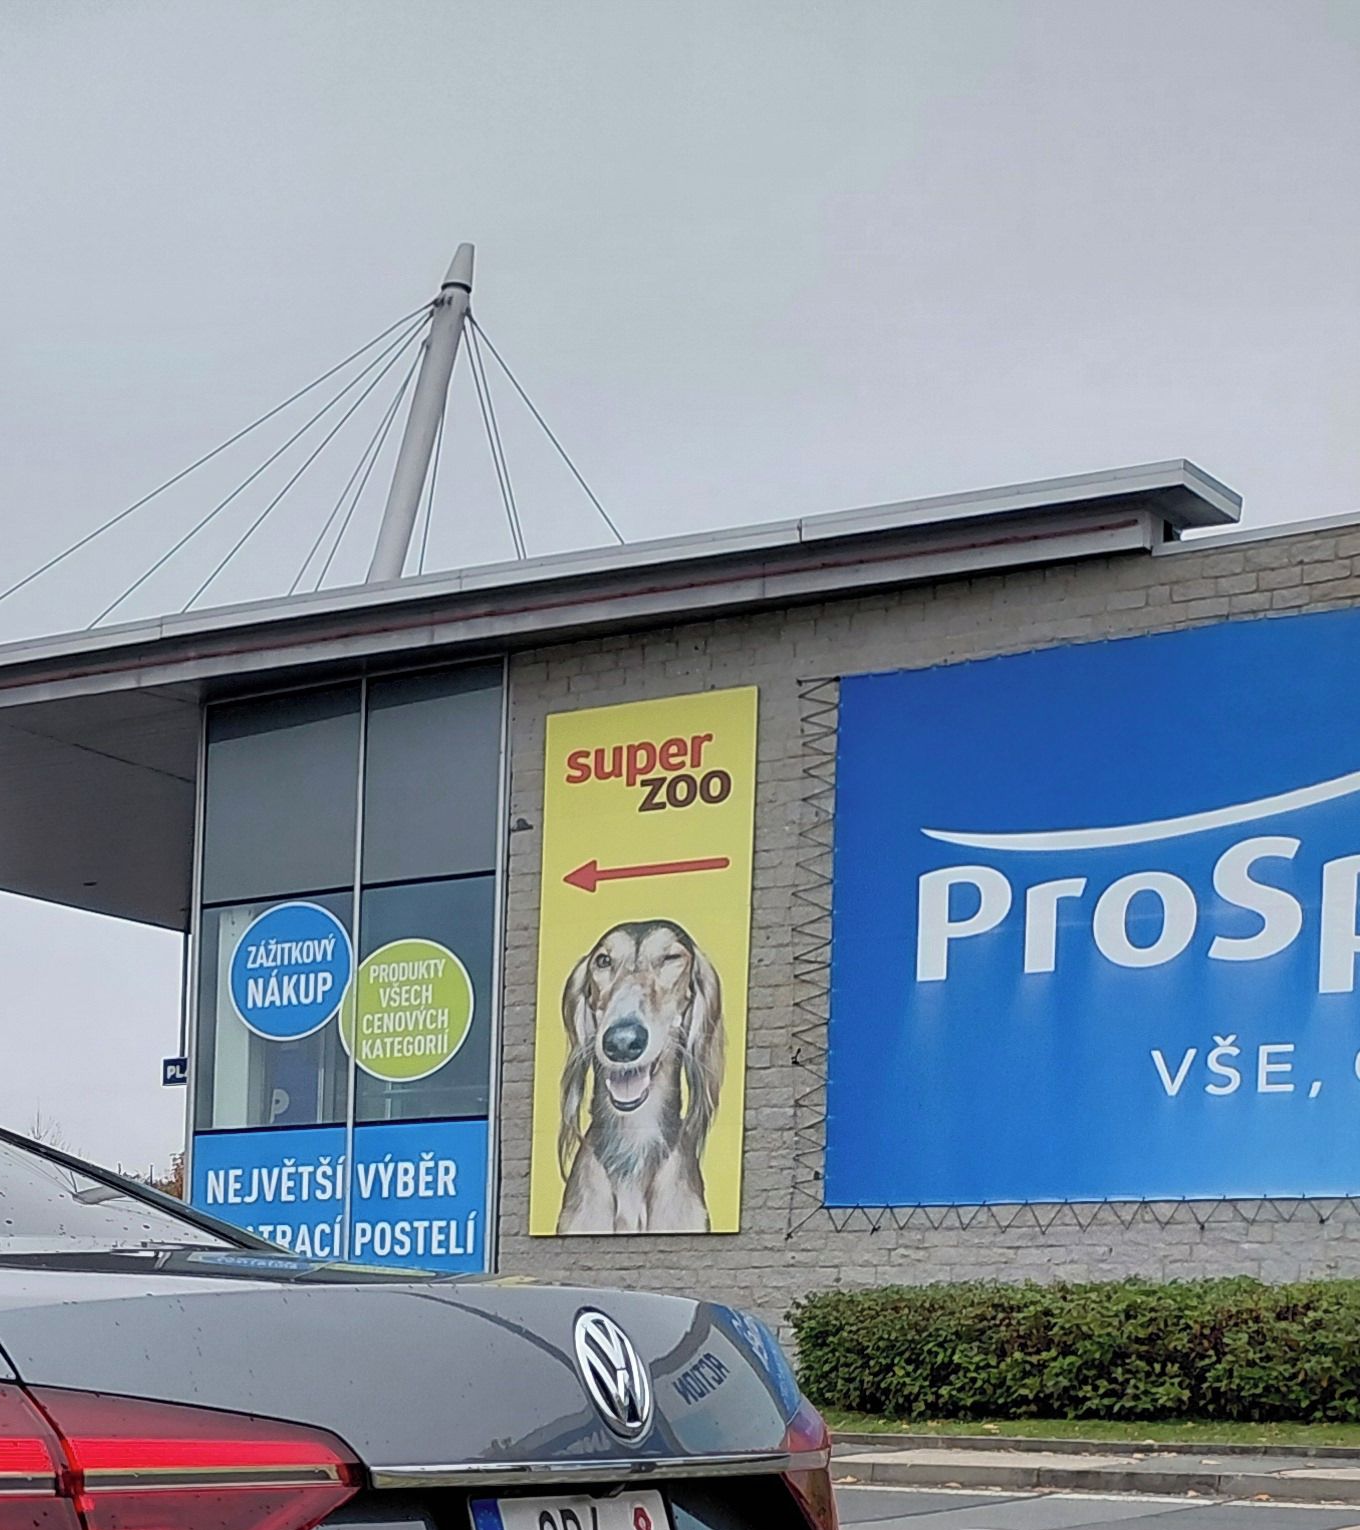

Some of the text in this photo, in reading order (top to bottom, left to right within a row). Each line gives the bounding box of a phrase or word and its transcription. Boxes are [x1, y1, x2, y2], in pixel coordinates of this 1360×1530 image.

[565, 732, 714, 788] super
[637, 769, 733, 813] zoo
[246, 933, 337, 969] ZÁŽITKOVÝ
[247, 968, 333, 1009] NÁKUP
[369, 958, 446, 984] PRODUKTY
[379, 979, 433, 1008] VŠECH
[362, 1006, 449, 1034] CENOVÝCH
[361, 1030, 449, 1060] KATEGORIÍ
[166, 1065, 187, 1080] PL
[1151, 1033, 1322, 1098] VŠE,
[206, 1151, 457, 1205] NEJVĚTŠÍ VÝBĚR
[246, 1210, 478, 1258] TRACÍ POSTELÍ
